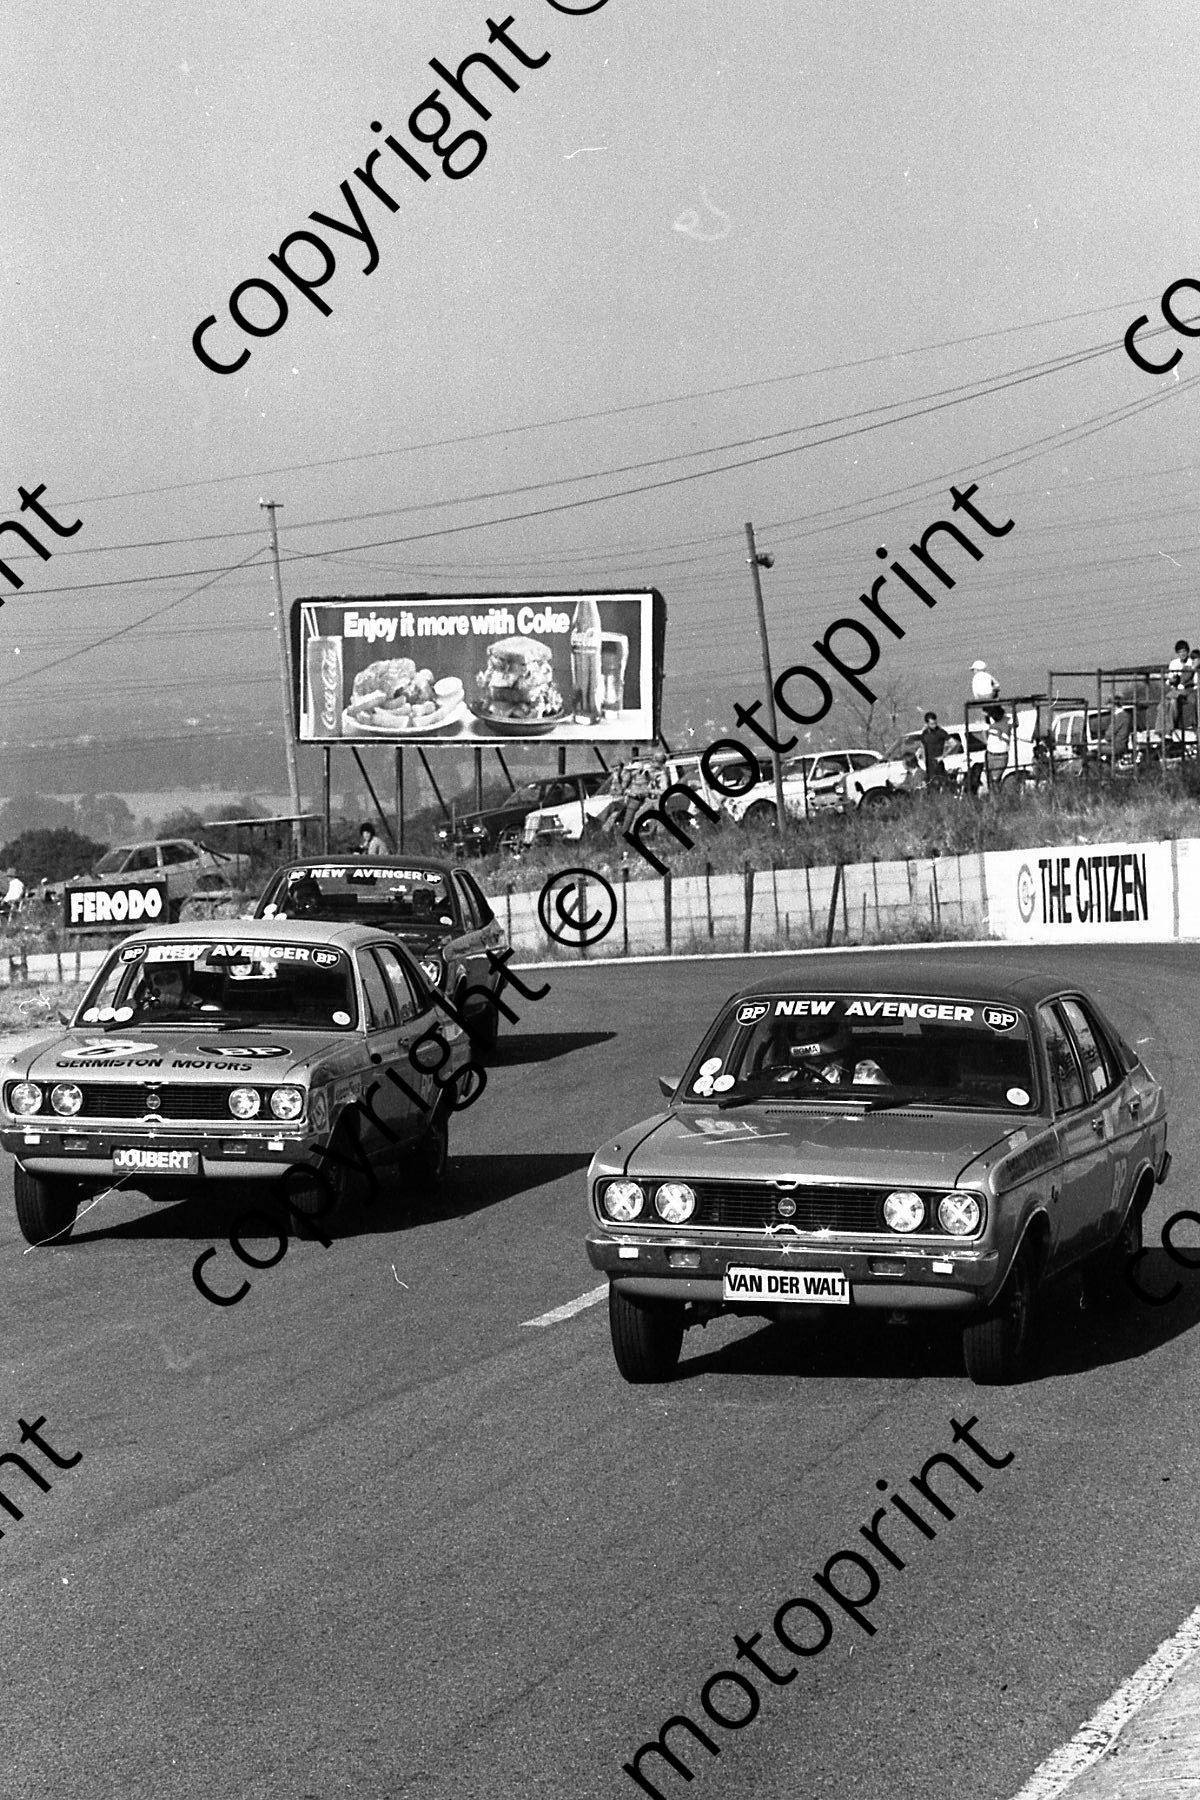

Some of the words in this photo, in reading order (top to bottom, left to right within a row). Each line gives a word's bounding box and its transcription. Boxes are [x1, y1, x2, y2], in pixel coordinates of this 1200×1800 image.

[344, 611, 398, 643] Enjoy
[400, 610, 415, 637] it
[417, 614, 470, 637] more
[470, 608, 515, 635] with
[517, 606, 570, 634] Coke
[310, 868, 346, 878] NEW
[352, 869, 422, 880] AVENGER
[1038, 857, 1072, 924] THE
[1076, 853, 1148, 923] CITIZEN
[70, 887, 163, 923] FERODO
[123, 948, 143, 960] BP
[210, 944, 310, 961] AVENGER
[316, 953, 337, 965] BP
[739, 1006, 766, 1021] BP
[774, 1001, 836, 1015] NEW
[844, 1001, 975, 1022] AVENGER
[987, 1011, 1015, 1027] BP
[212, 1047, 282, 1056] BP
[56, 1058, 164, 1068] GERMISTON
[171, 1059, 253, 1071] MOTORS
[115, 1149, 192, 1169] JOUBERT
[727, 1273, 763, 1293] VAN
[767, 1275, 800, 1294] DER
[803, 1277, 849, 1296] WALT
